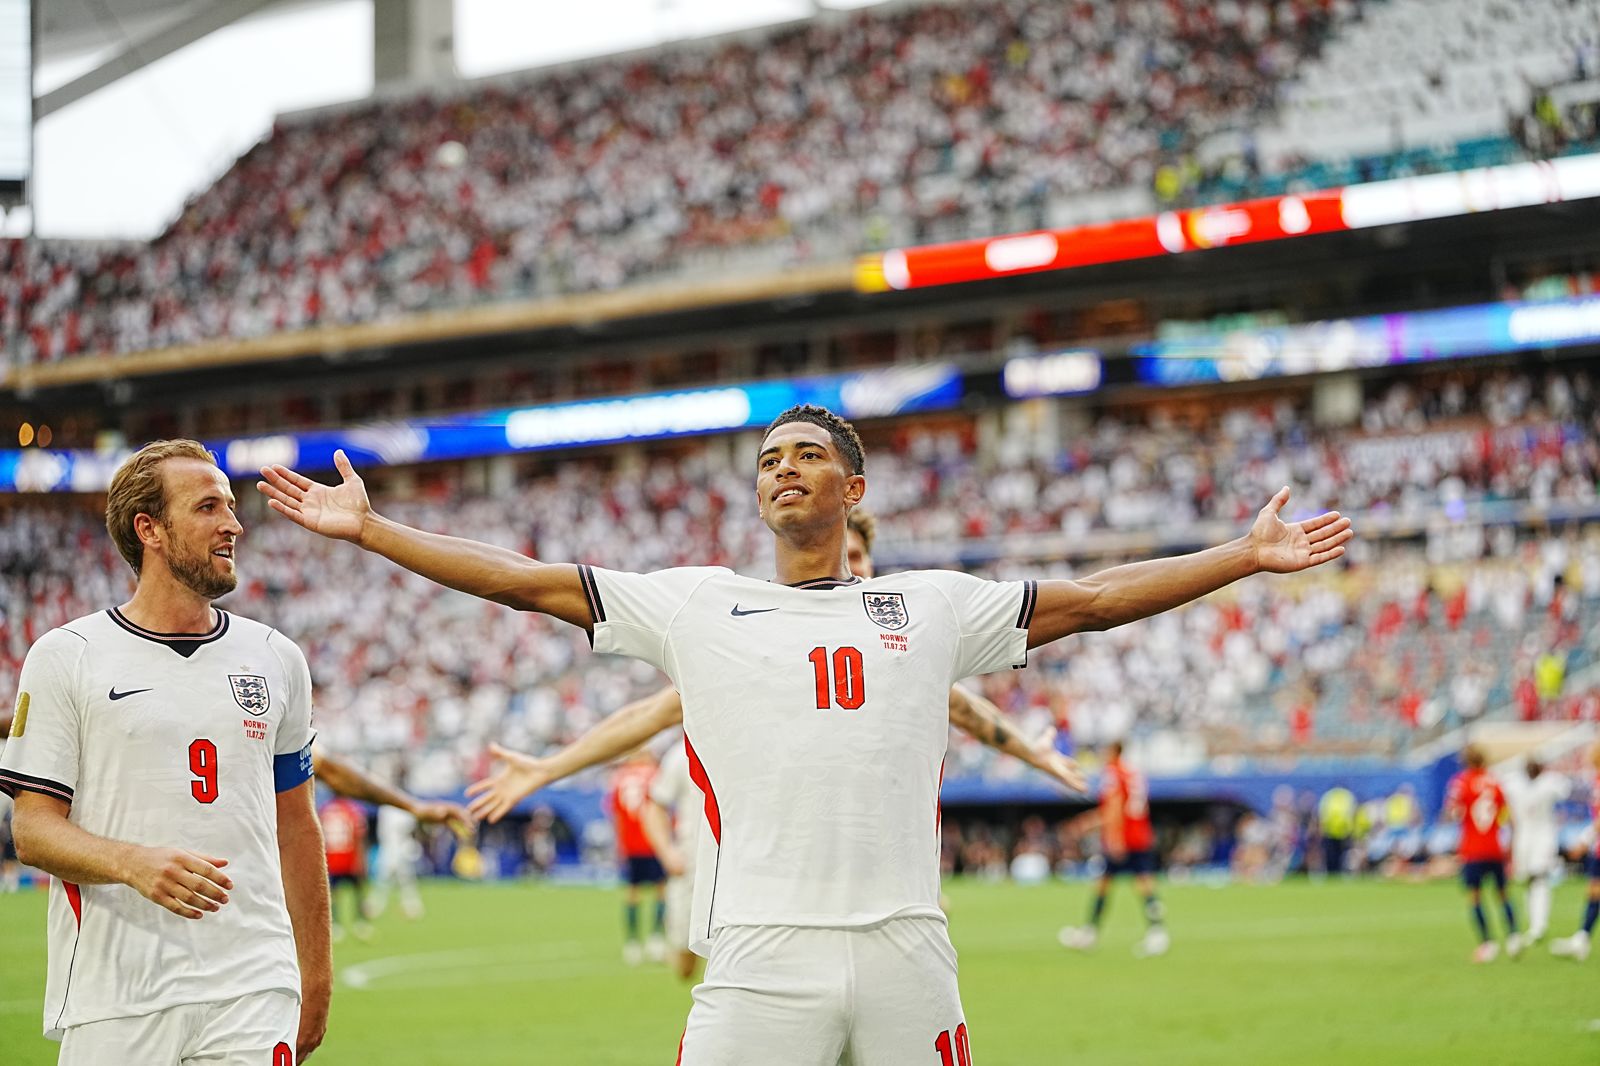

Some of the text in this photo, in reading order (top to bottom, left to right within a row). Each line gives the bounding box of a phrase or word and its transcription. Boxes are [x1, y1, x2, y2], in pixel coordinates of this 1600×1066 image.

[880, 633, 908, 643] NORWAY
[808, 646, 866, 710] 10
[243, 719, 268, 730] NORWAY
[188, 738, 219, 804] 9
[934, 1021, 972, 1066] 10
